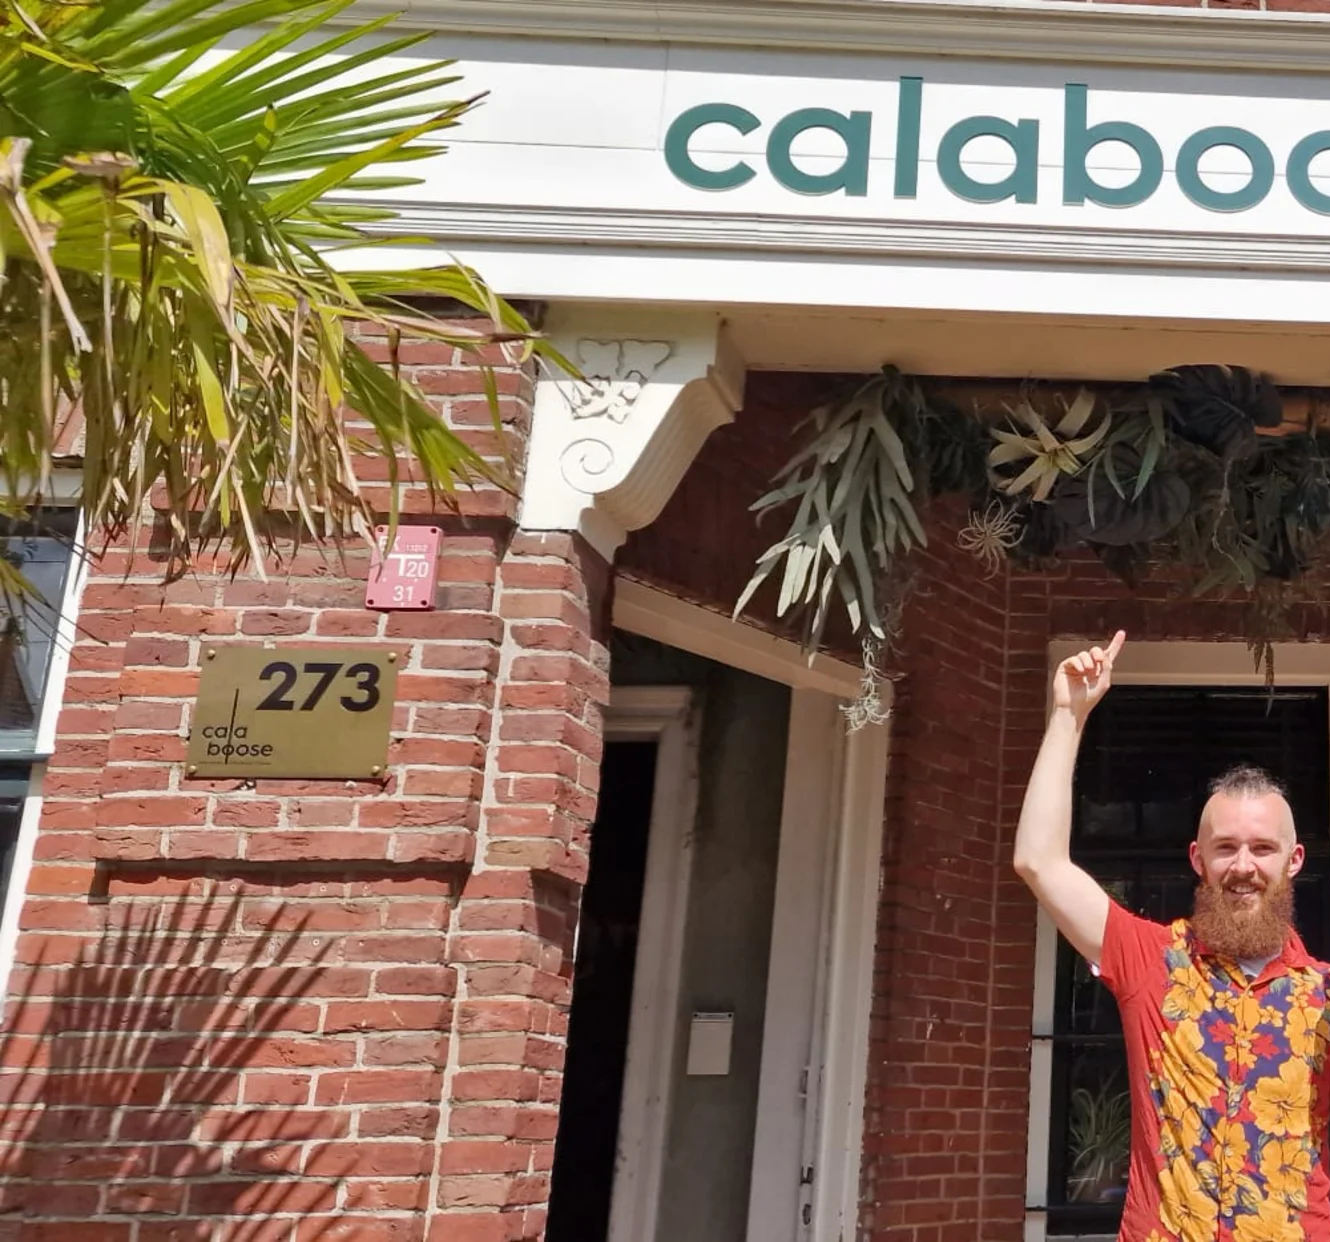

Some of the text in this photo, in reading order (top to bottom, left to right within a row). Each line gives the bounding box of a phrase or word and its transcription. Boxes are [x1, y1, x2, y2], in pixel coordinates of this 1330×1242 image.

[393, 585, 414, 601] 31
[255, 661, 380, 712] 273
[206, 742, 274, 757] boose
